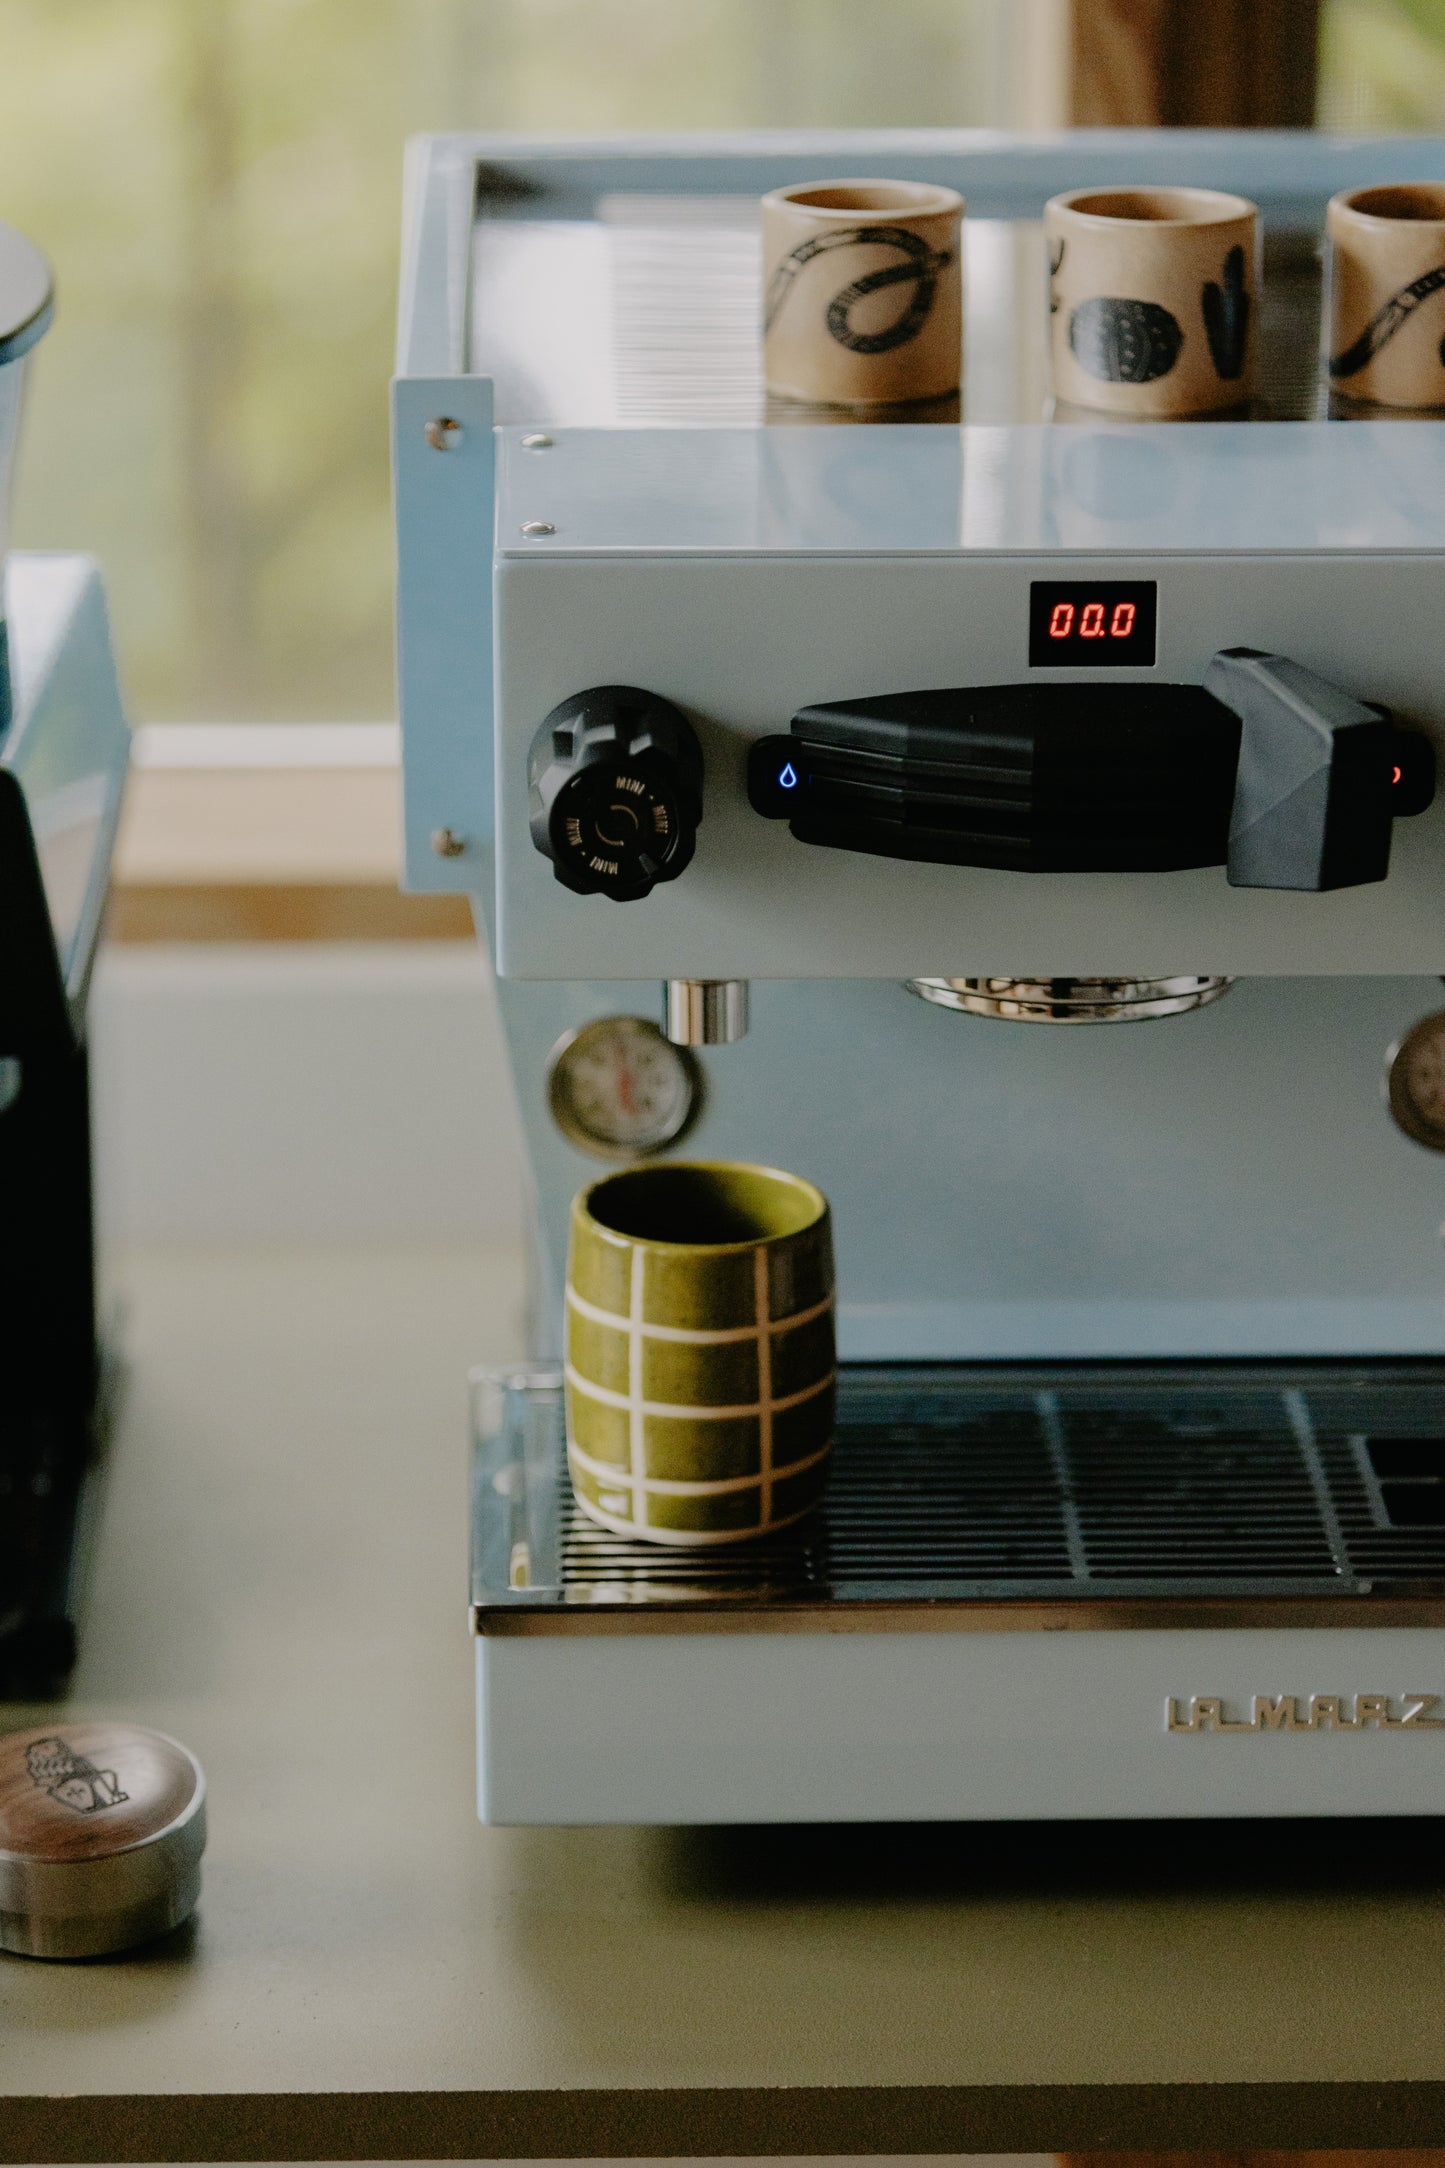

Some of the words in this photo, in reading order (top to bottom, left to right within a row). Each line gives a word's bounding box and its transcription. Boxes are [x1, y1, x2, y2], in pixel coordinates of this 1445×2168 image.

[1050, 603, 1136, 637] 00.0
[616, 776, 645, 795] MINI
[590, 856, 618, 875] MINI
[1164, 1696, 1223, 1732] LA
